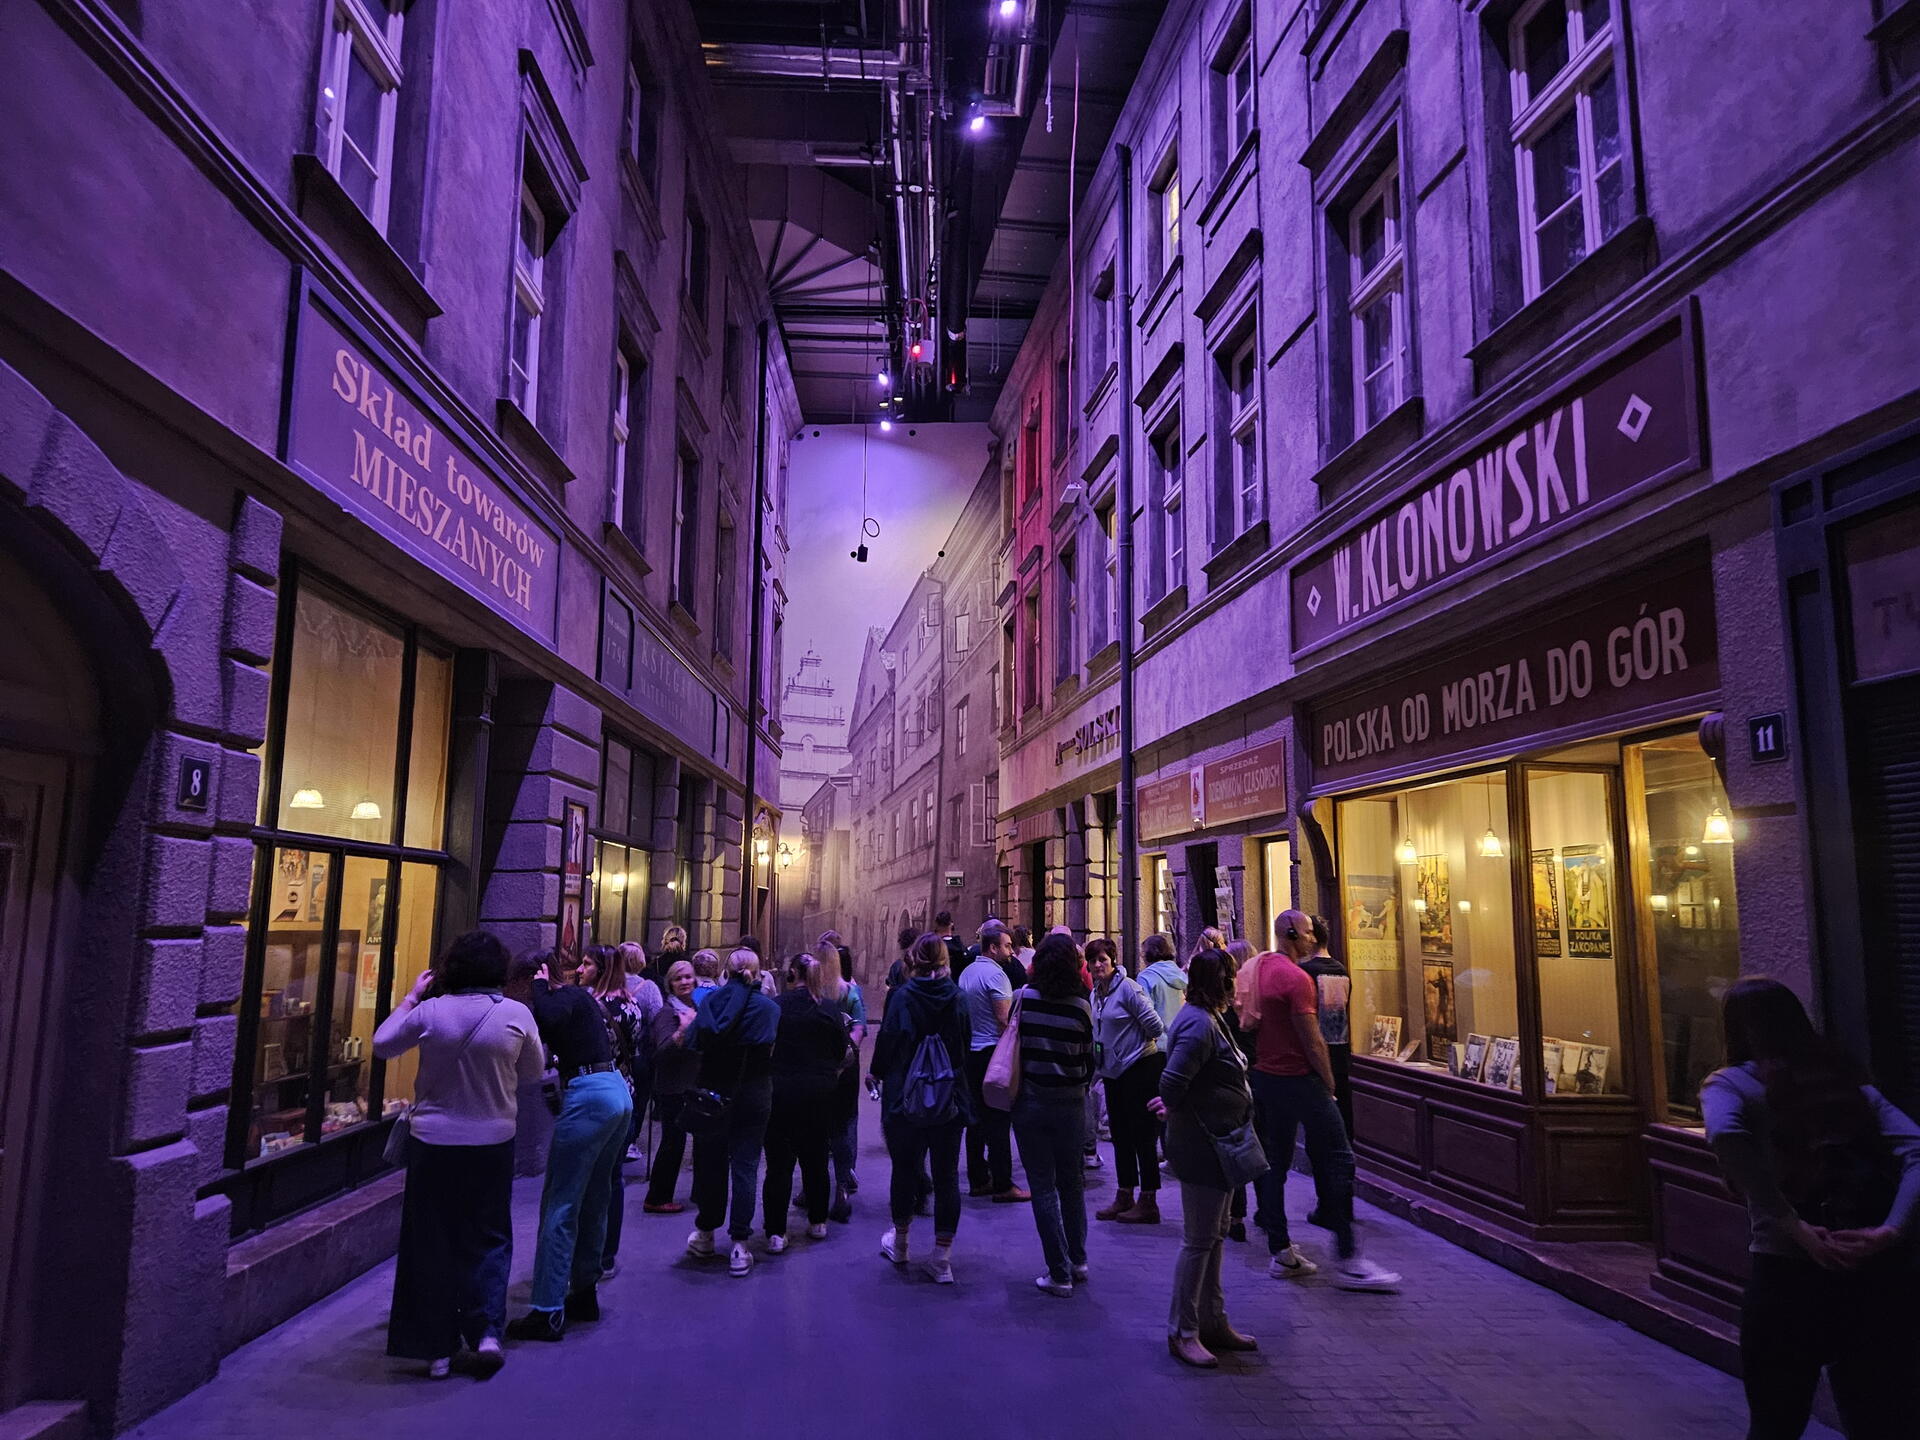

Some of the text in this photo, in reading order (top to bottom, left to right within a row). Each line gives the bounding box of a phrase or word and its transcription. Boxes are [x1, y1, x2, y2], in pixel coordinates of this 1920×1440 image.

[333, 349, 545, 568] Skład towarów
[350, 428, 532, 611] MIESZANYCH
[1323, 602, 1688, 766] POLSKA OD MORZA DO GÓR
[190, 768, 202, 796] 8
[1756, 724, 1775, 753] 11
[1569, 941, 1611, 953] ZAKOPANE
